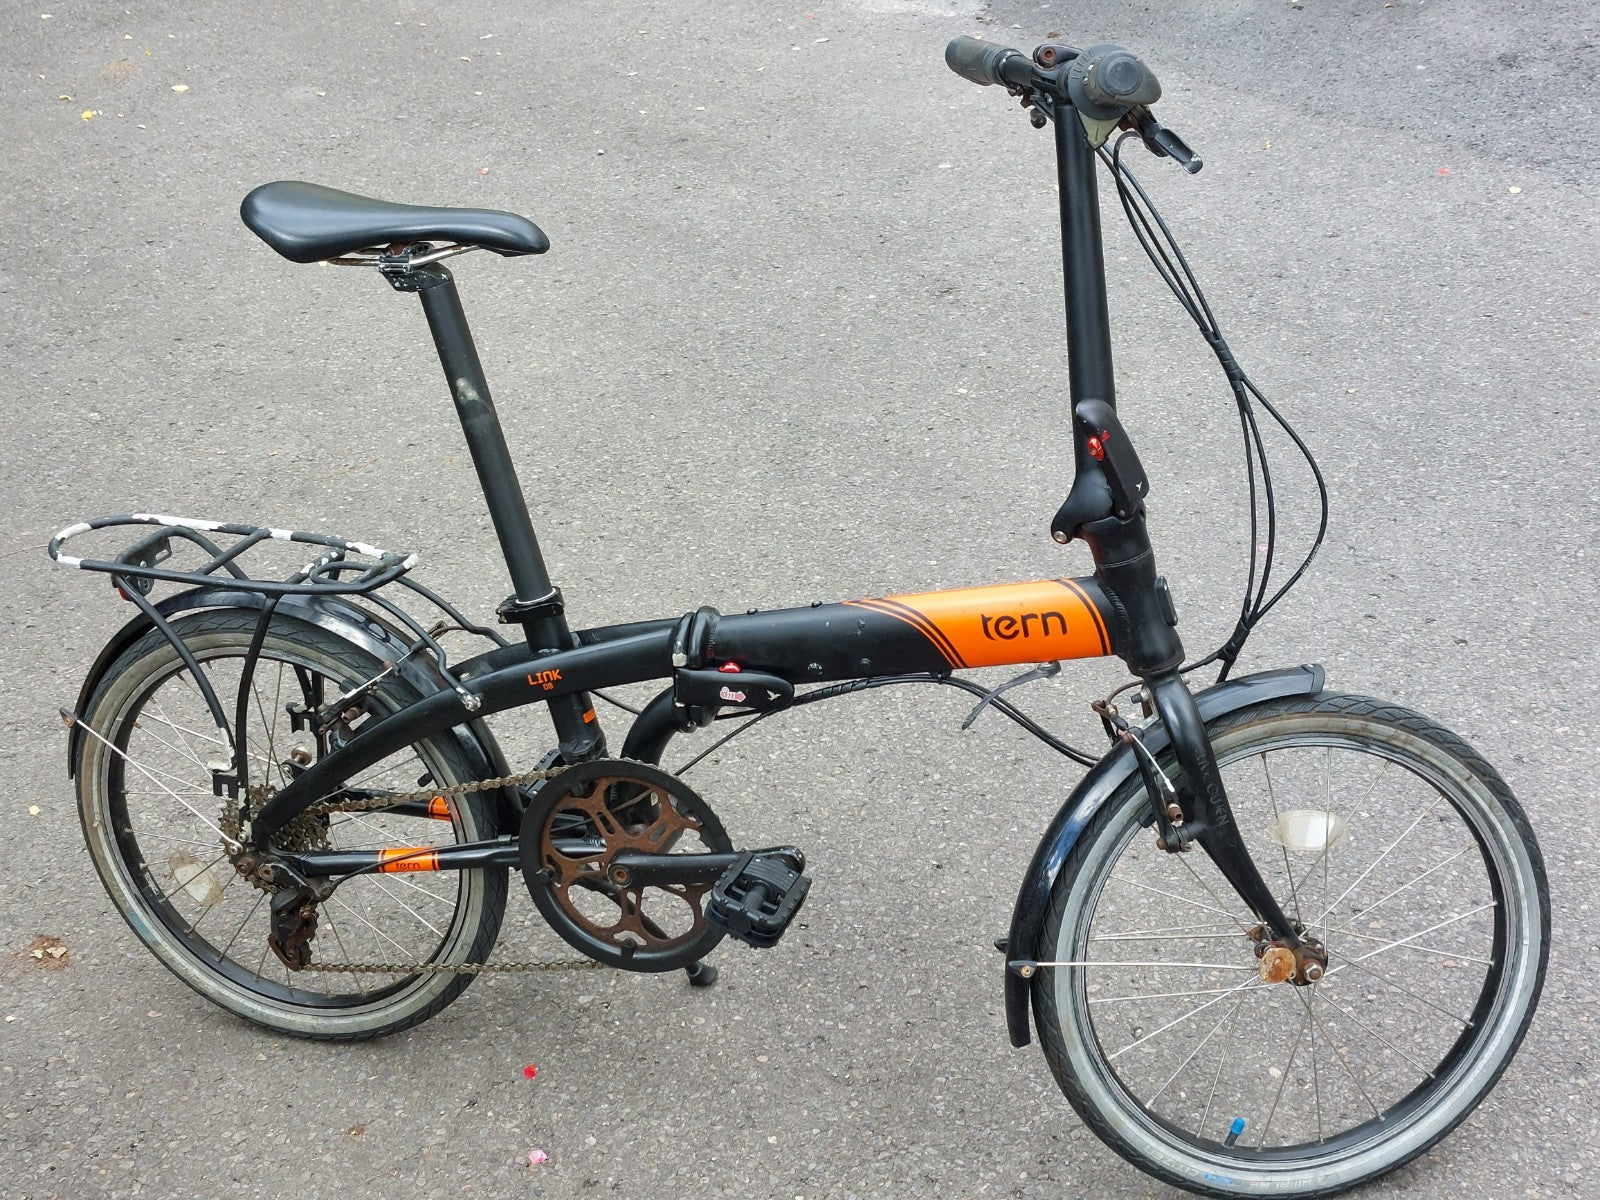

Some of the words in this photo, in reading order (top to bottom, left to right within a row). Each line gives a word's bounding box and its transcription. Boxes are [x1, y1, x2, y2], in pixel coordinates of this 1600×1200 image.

[981, 611, 1067, 641] tern
[528, 669, 562, 685] LINK
[396, 862, 421, 870] tern
